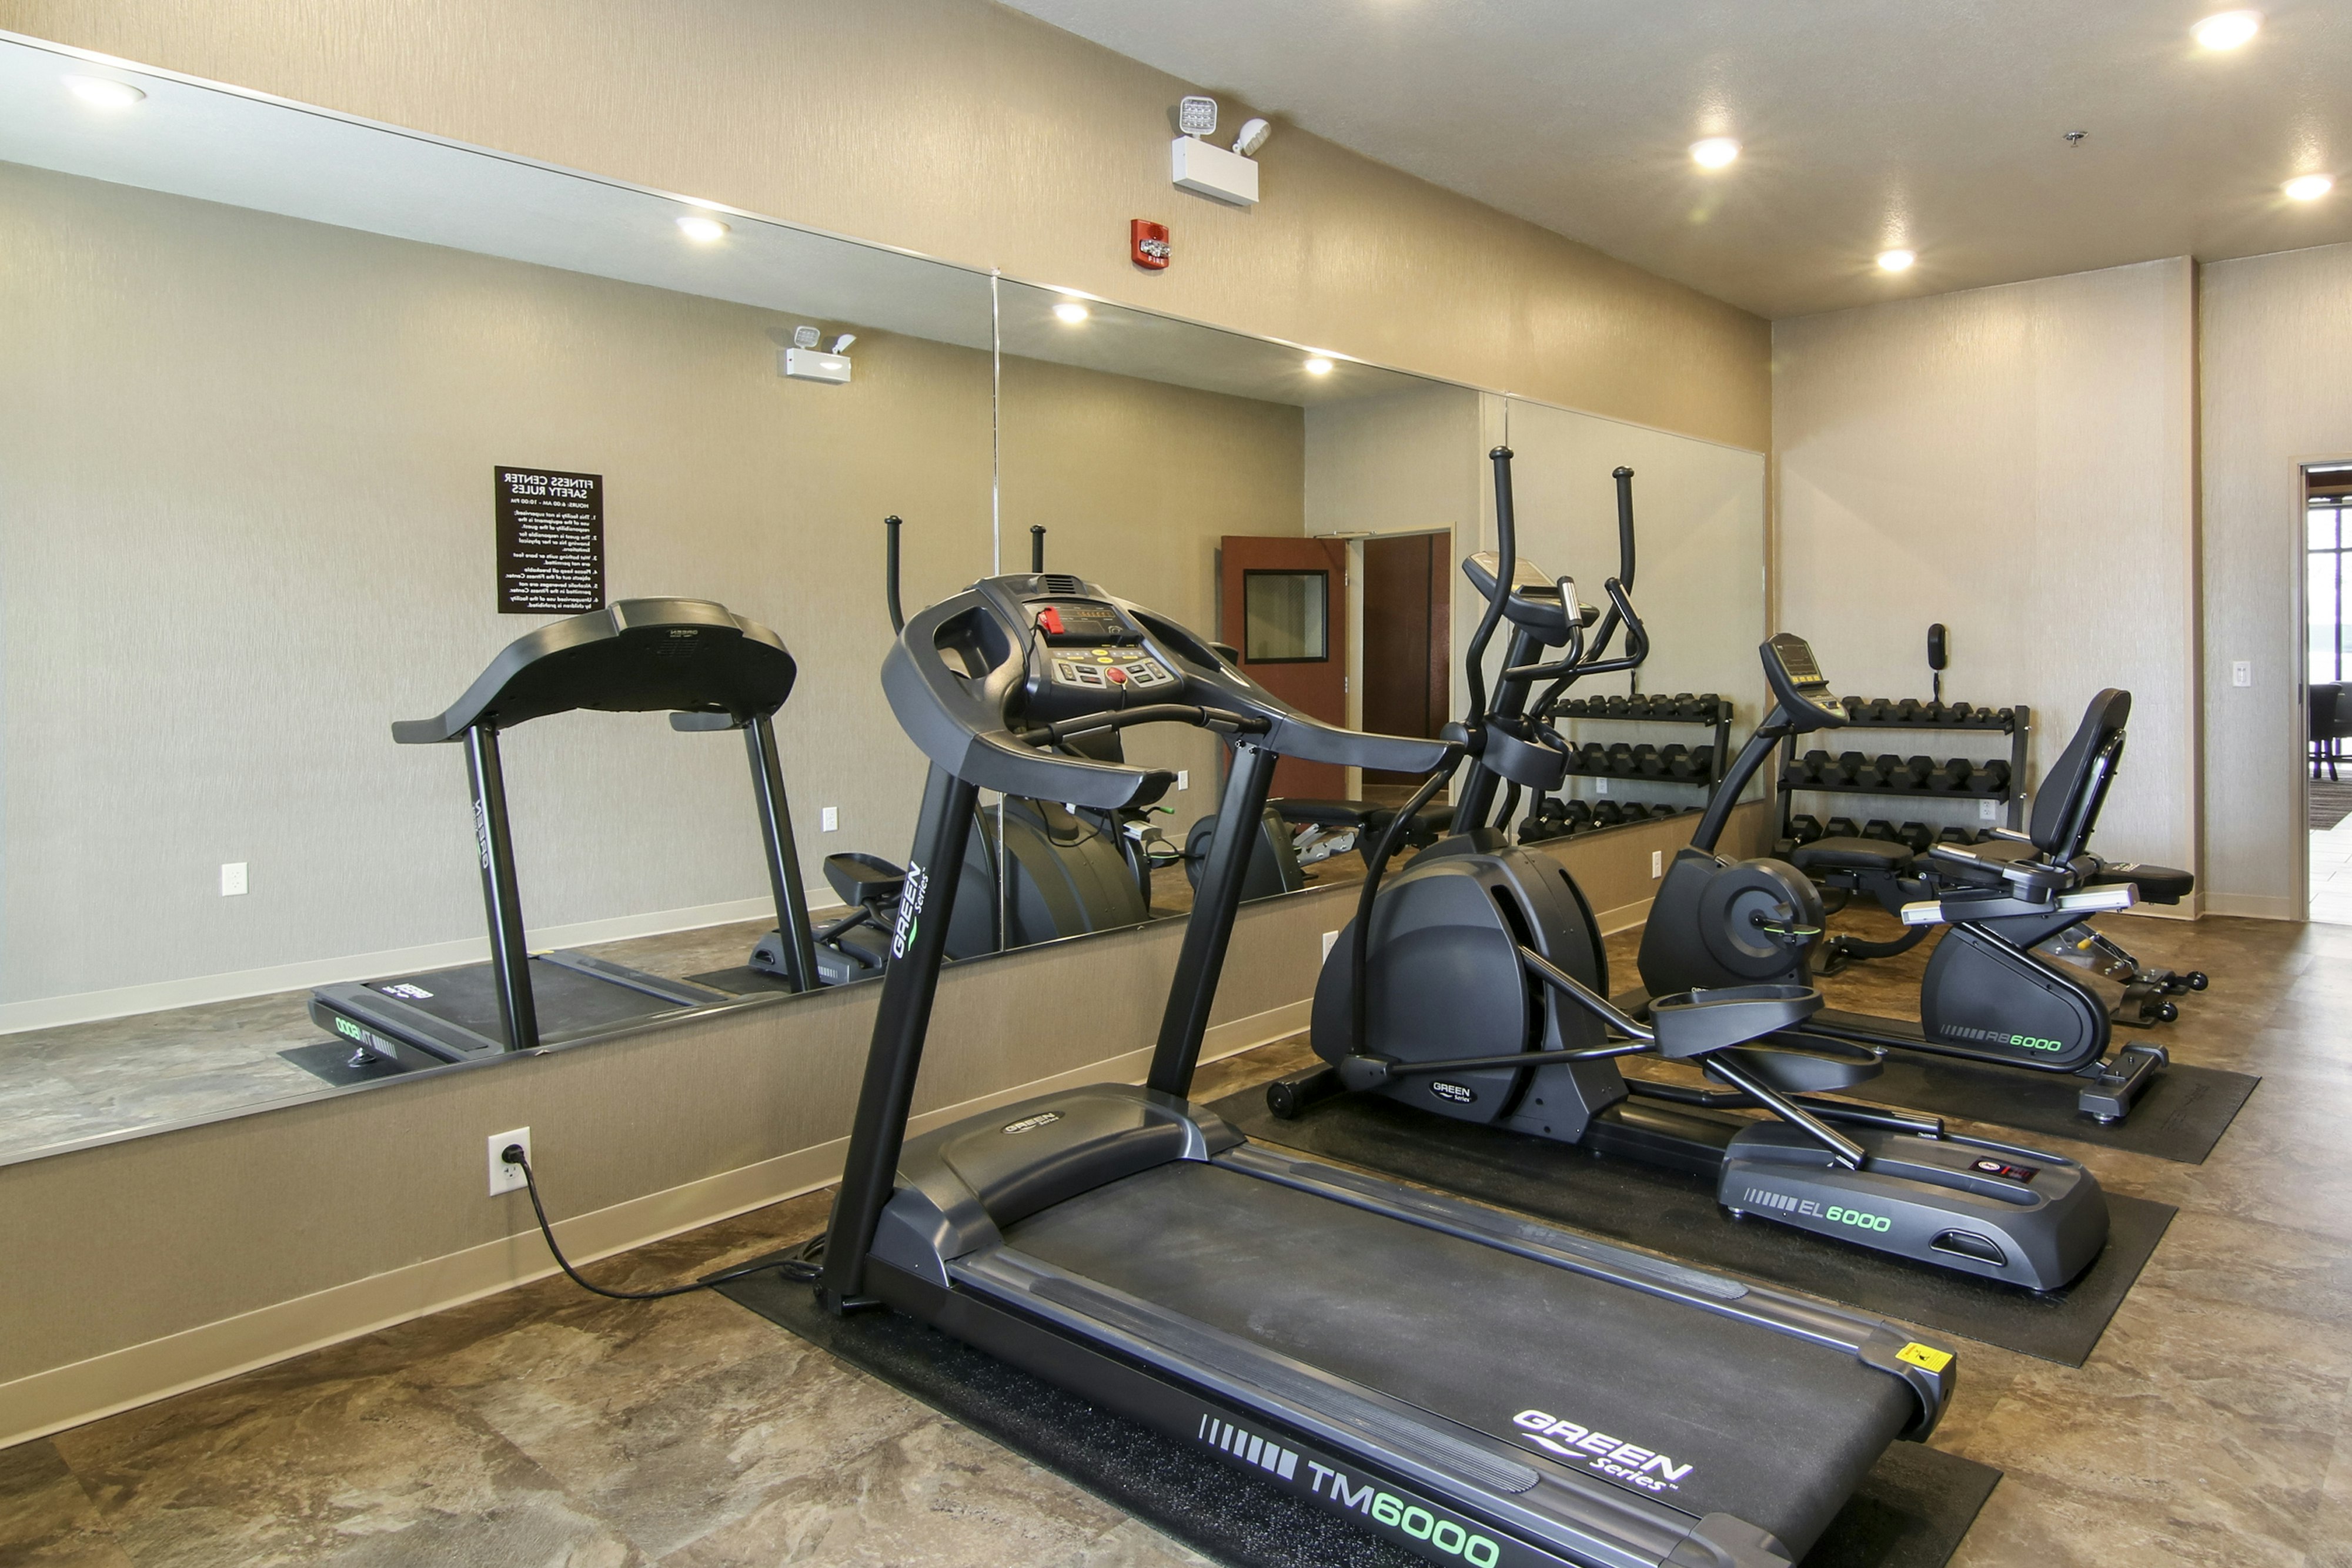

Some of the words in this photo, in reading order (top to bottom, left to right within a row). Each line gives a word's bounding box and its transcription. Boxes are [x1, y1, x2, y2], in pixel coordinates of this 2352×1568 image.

[1148, 255, 1164, 265] FIRE
[893, 861, 921, 959] GREEN
[914, 873, 928, 914] Series
[1986, 1031, 2062, 1051] RB6000
[1434, 1082, 1470, 1096] GREEN
[1005, 1112, 1055, 1132] GREEN
[1513, 1409, 1693, 1481] GREEN
[1589, 1457, 1667, 1491] Series
[1308, 1460, 1500, 1568] TM6000
